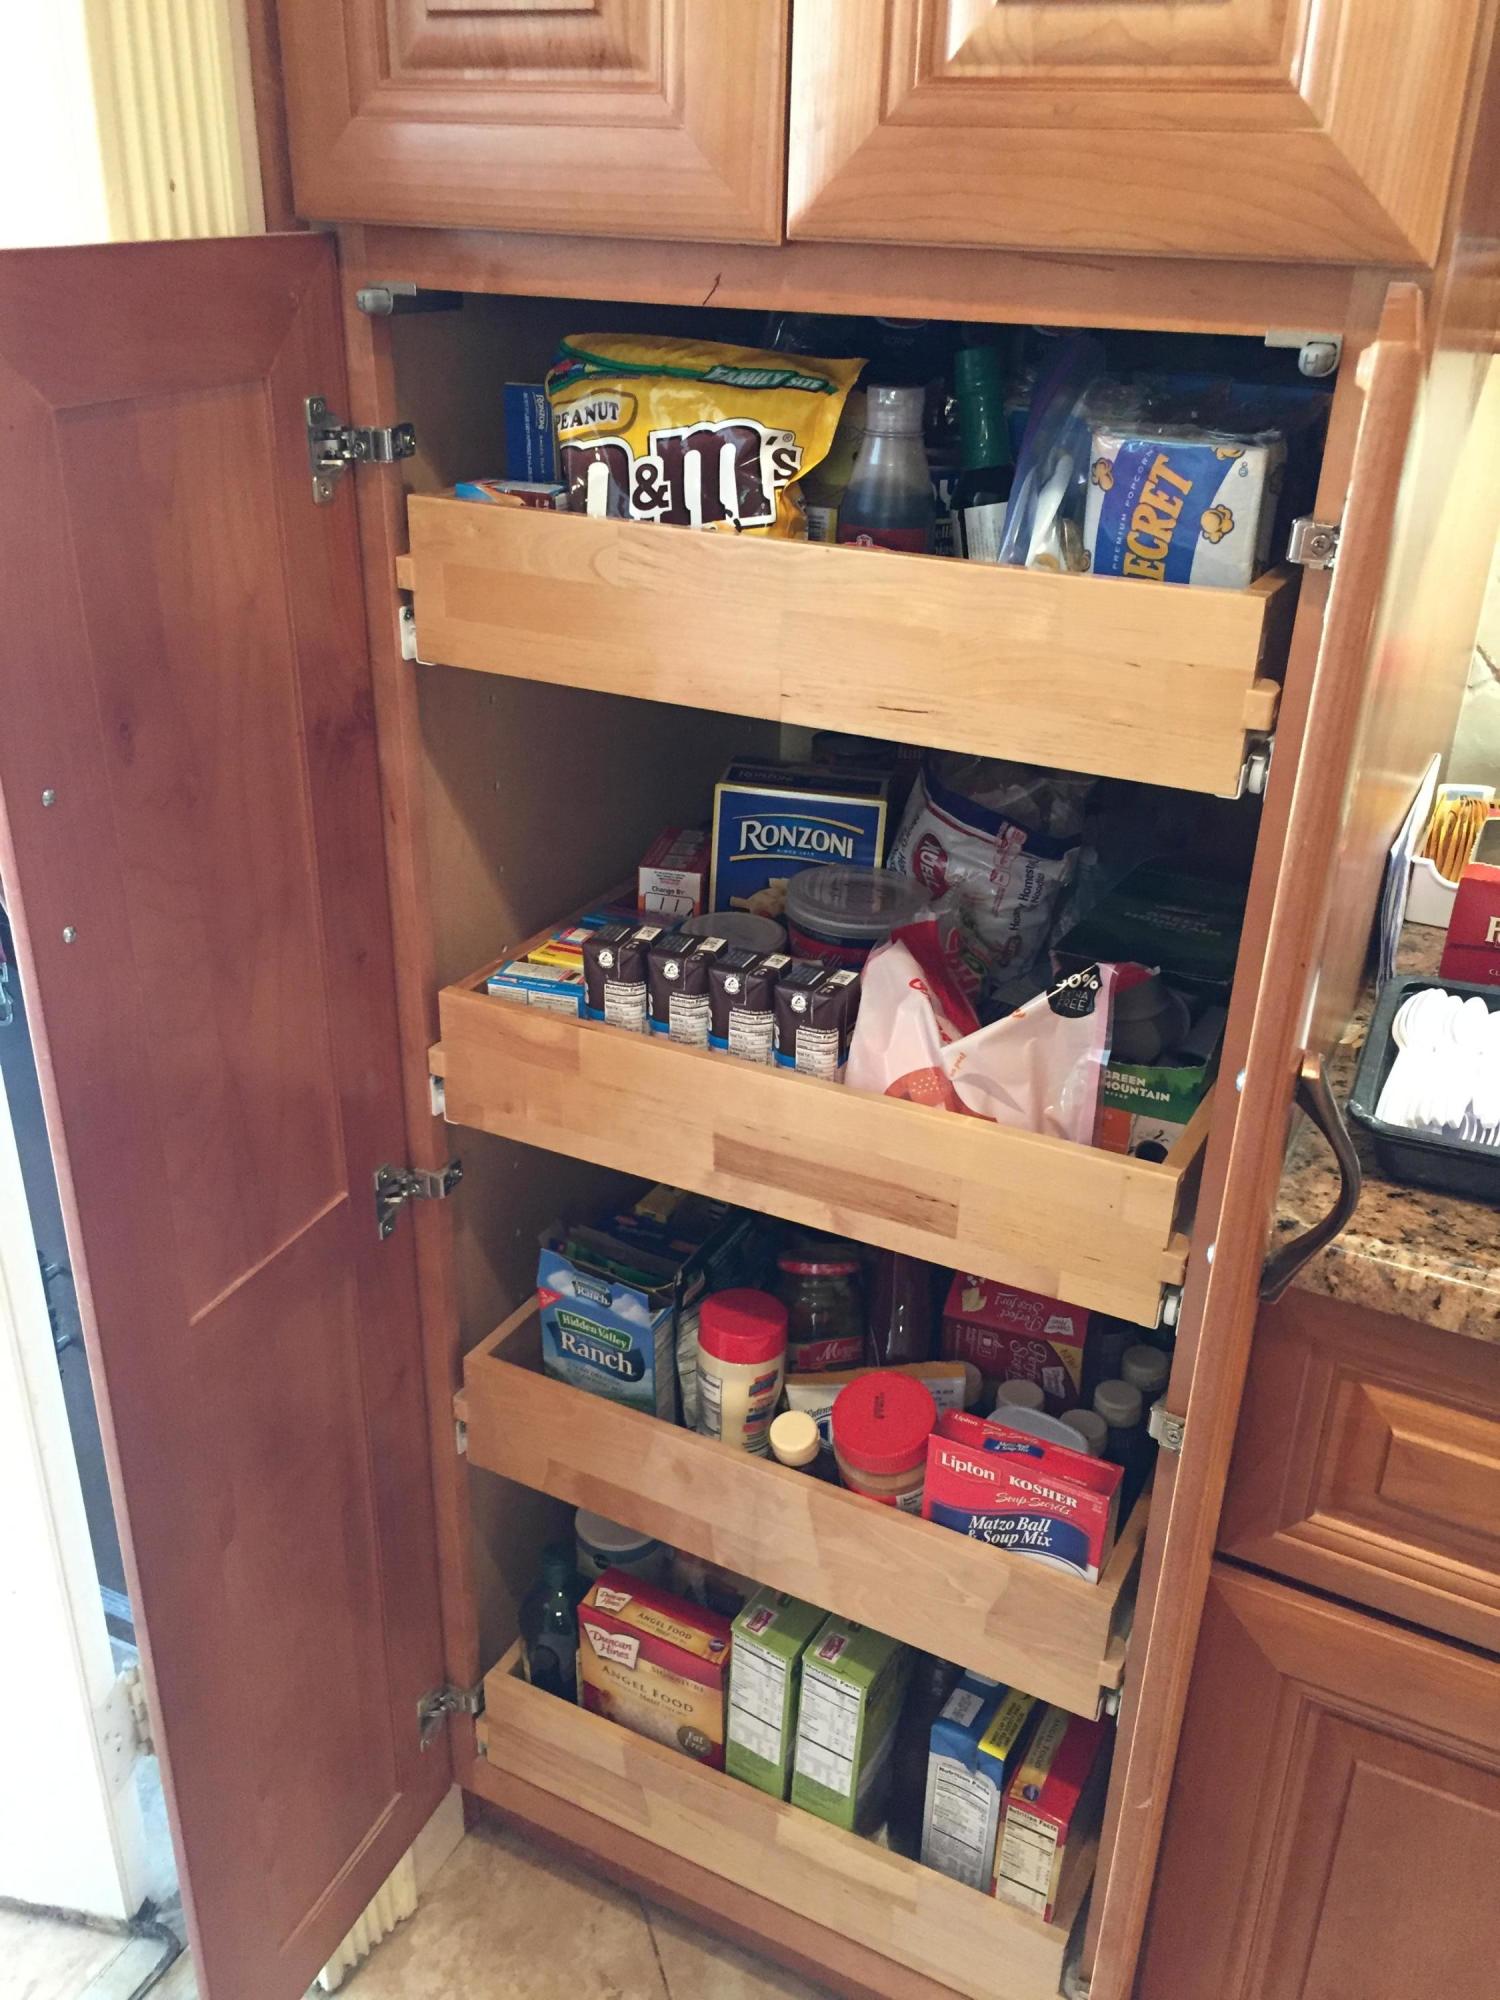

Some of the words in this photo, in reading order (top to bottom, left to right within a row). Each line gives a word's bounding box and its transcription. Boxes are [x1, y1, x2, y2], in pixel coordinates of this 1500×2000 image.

[706, 366, 788, 387] FAMILY
[554, 401, 619, 430] PEANUT
[1123, 454, 1193, 582] ECRET
[1111, 513, 1129, 571] PREMIUM
[739, 820, 855, 859] RONZONI
[577, 1286, 610, 1305] Ranch
[561, 1314, 597, 1334] Hidden
[596, 1329, 628, 1349] Valley
[560, 1331, 633, 1376] Ranch
[954, 1413, 979, 1426] Lipton
[941, 1451, 996, 1481] Lipton
[1009, 1474, 1078, 1509] KOSHER
[995, 1492, 1028, 1509] Soup
[1029, 1498, 1073, 1516] Secrets
[968, 1515, 1015, 1531] Matzo
[1016, 1515, 1052, 1532] Ball
[968, 1529, 978, 1539] &
[984, 1530, 1019, 1547] Soup
[1020, 1532, 1053, 1547] Mix
[638, 1611, 666, 1629] ANGEL
[666, 1624, 693, 1641] FOOD
[589, 1628, 633, 1652] Duncan
[600, 1643, 630, 1660] Hines
[602, 1665, 648, 1693] ANGEL
[652, 1687, 694, 1713] FOOD
[686, 1730, 705, 1746] Fat
